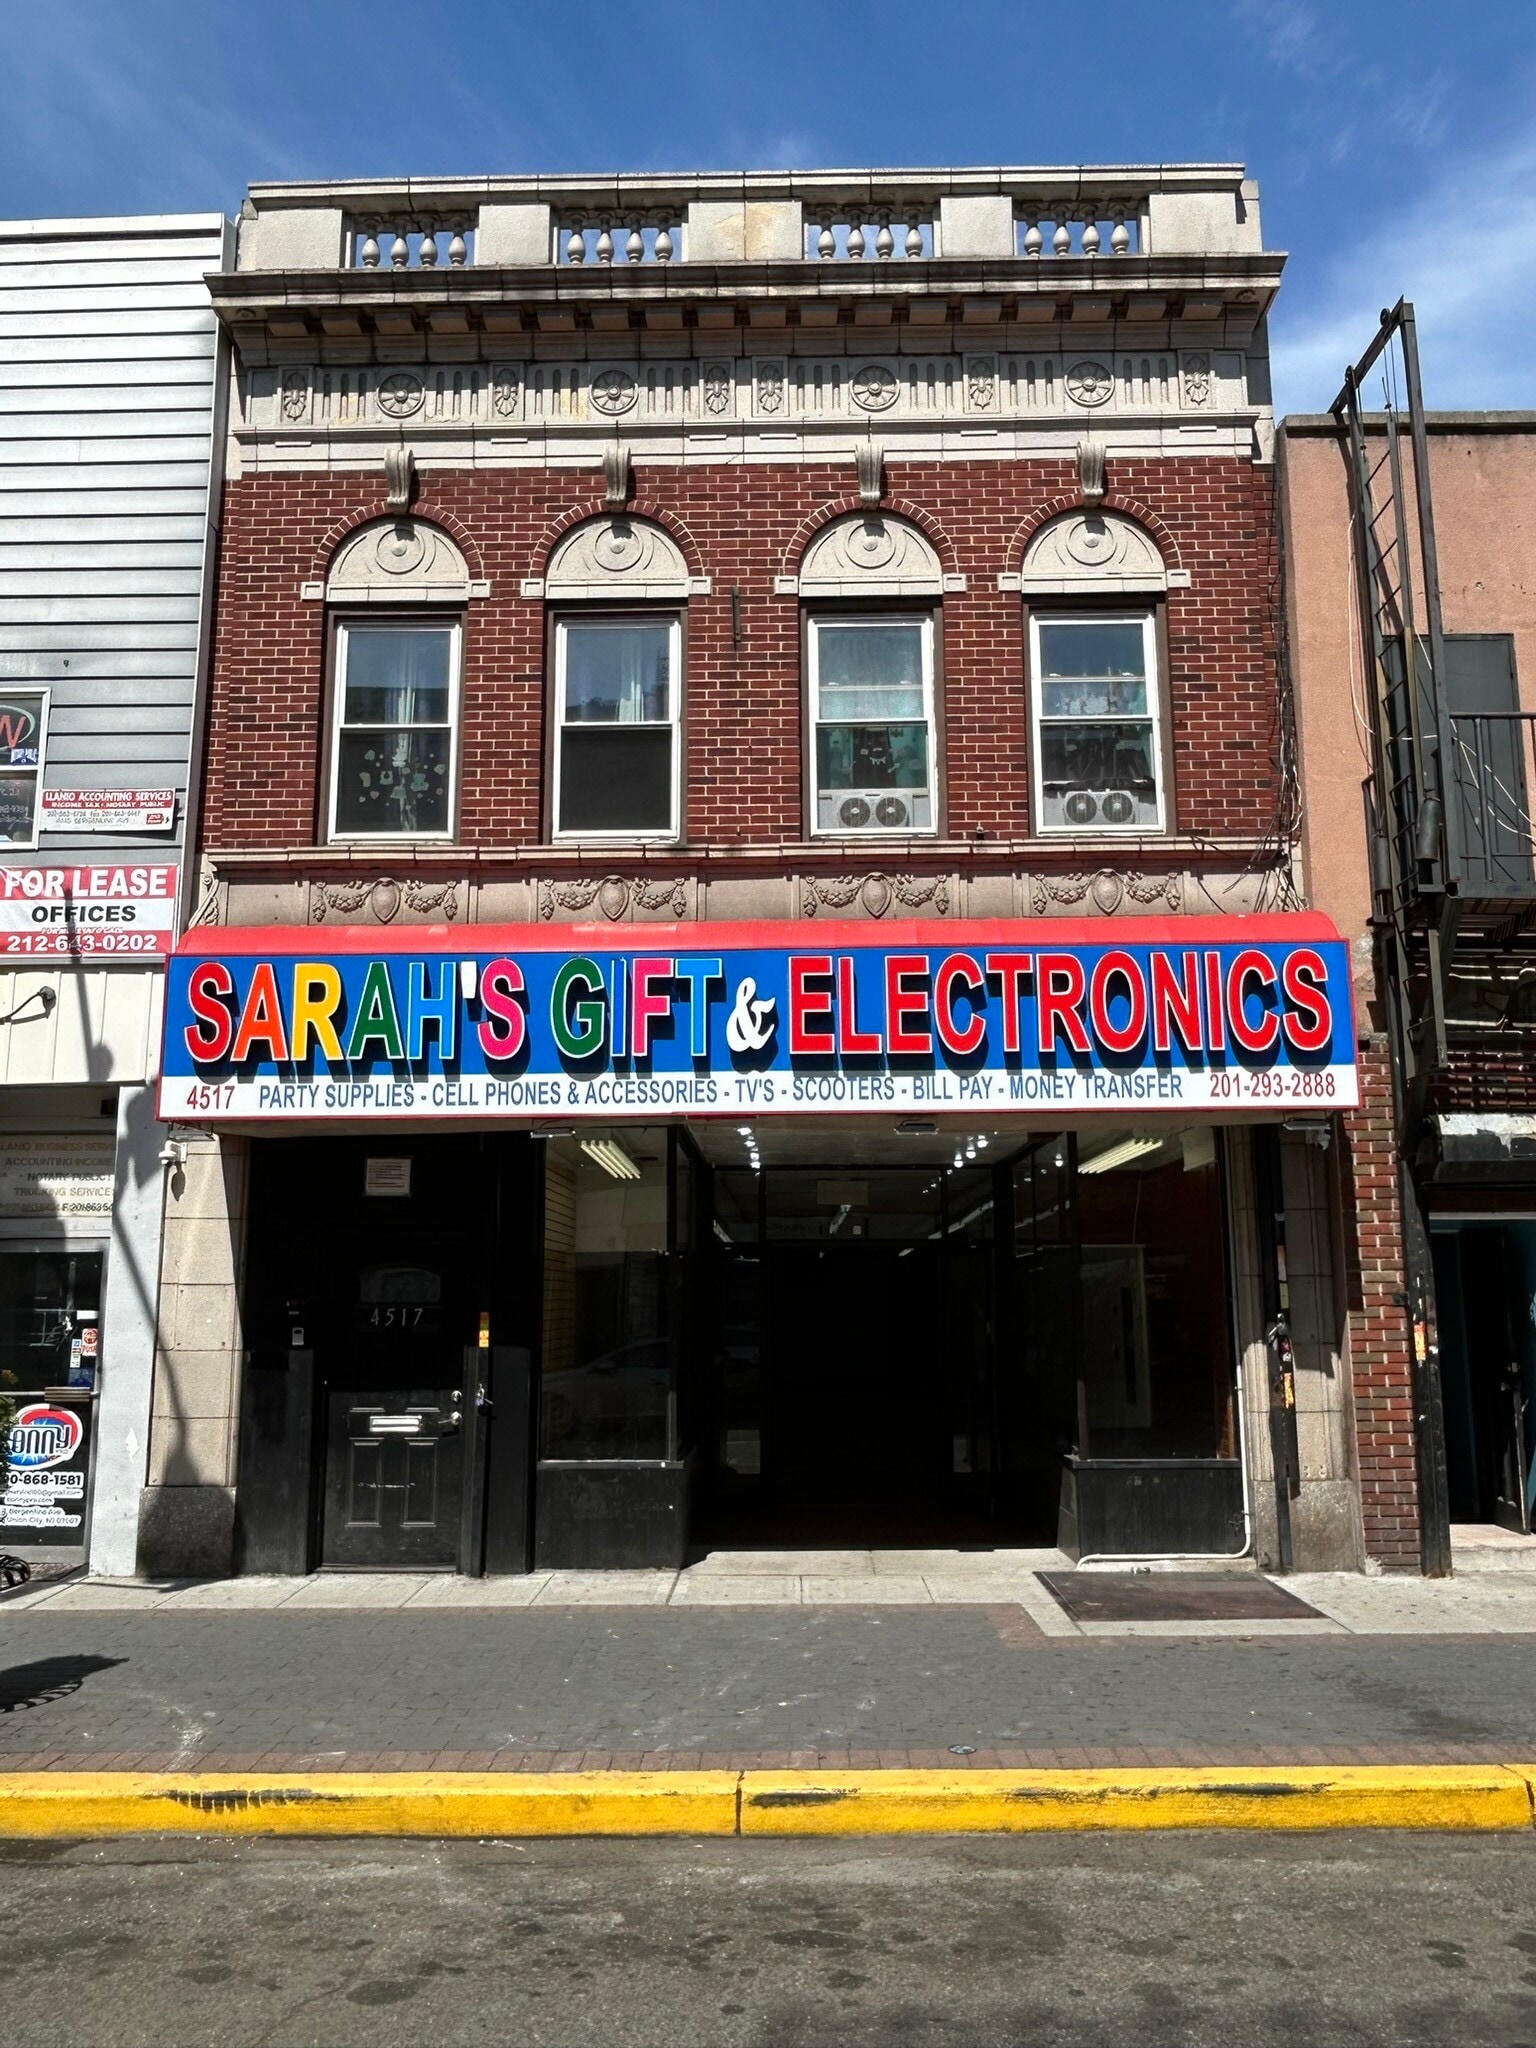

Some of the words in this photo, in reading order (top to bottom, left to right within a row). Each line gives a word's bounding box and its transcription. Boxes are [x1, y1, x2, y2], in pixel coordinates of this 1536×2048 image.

[79, 791, 132, 801] ACCOUNTING
[136, 791, 171, 800] SERVICES
[5, 869, 65, 897] FOR
[72, 868, 169, 897] LEASE
[31, 905, 137, 923] OFFICES
[184, 957, 525, 1063] SARAH'S
[550, 957, 722, 1058] GIFT
[726, 977, 775, 1053] &
[787, 949, 1332, 1056] ELECTRONICS
[186, 1085, 235, 1110] 4517
[259, 1085, 319, 1109] PARTY
[325, 1083, 414, 1108] SUPPLIES
[432, 1082, 479, 1106] CELL
[485, 1081, 561, 1105] PHONES
[567, 1081, 580, 1104] &
[584, 1079, 717, 1104] ACCESSORIES
[735, 1078, 775, 1103] TV'S
[793, 1076, 895, 1101] SCOOTERS
[913, 1076, 953, 1100] BILL
[959, 1076, 993, 1100] PAY
[1010, 1075, 1076, 1099] MONEY
[1082, 1074, 1183, 1098] TRANSFER
[1210, 1073, 1336, 1098] 201-293-2888
[370, 1308, 423, 1326] 4517
[6, 1426, 71, 1453] onny
[4, 1474, 81, 1486] 0-868-1581
